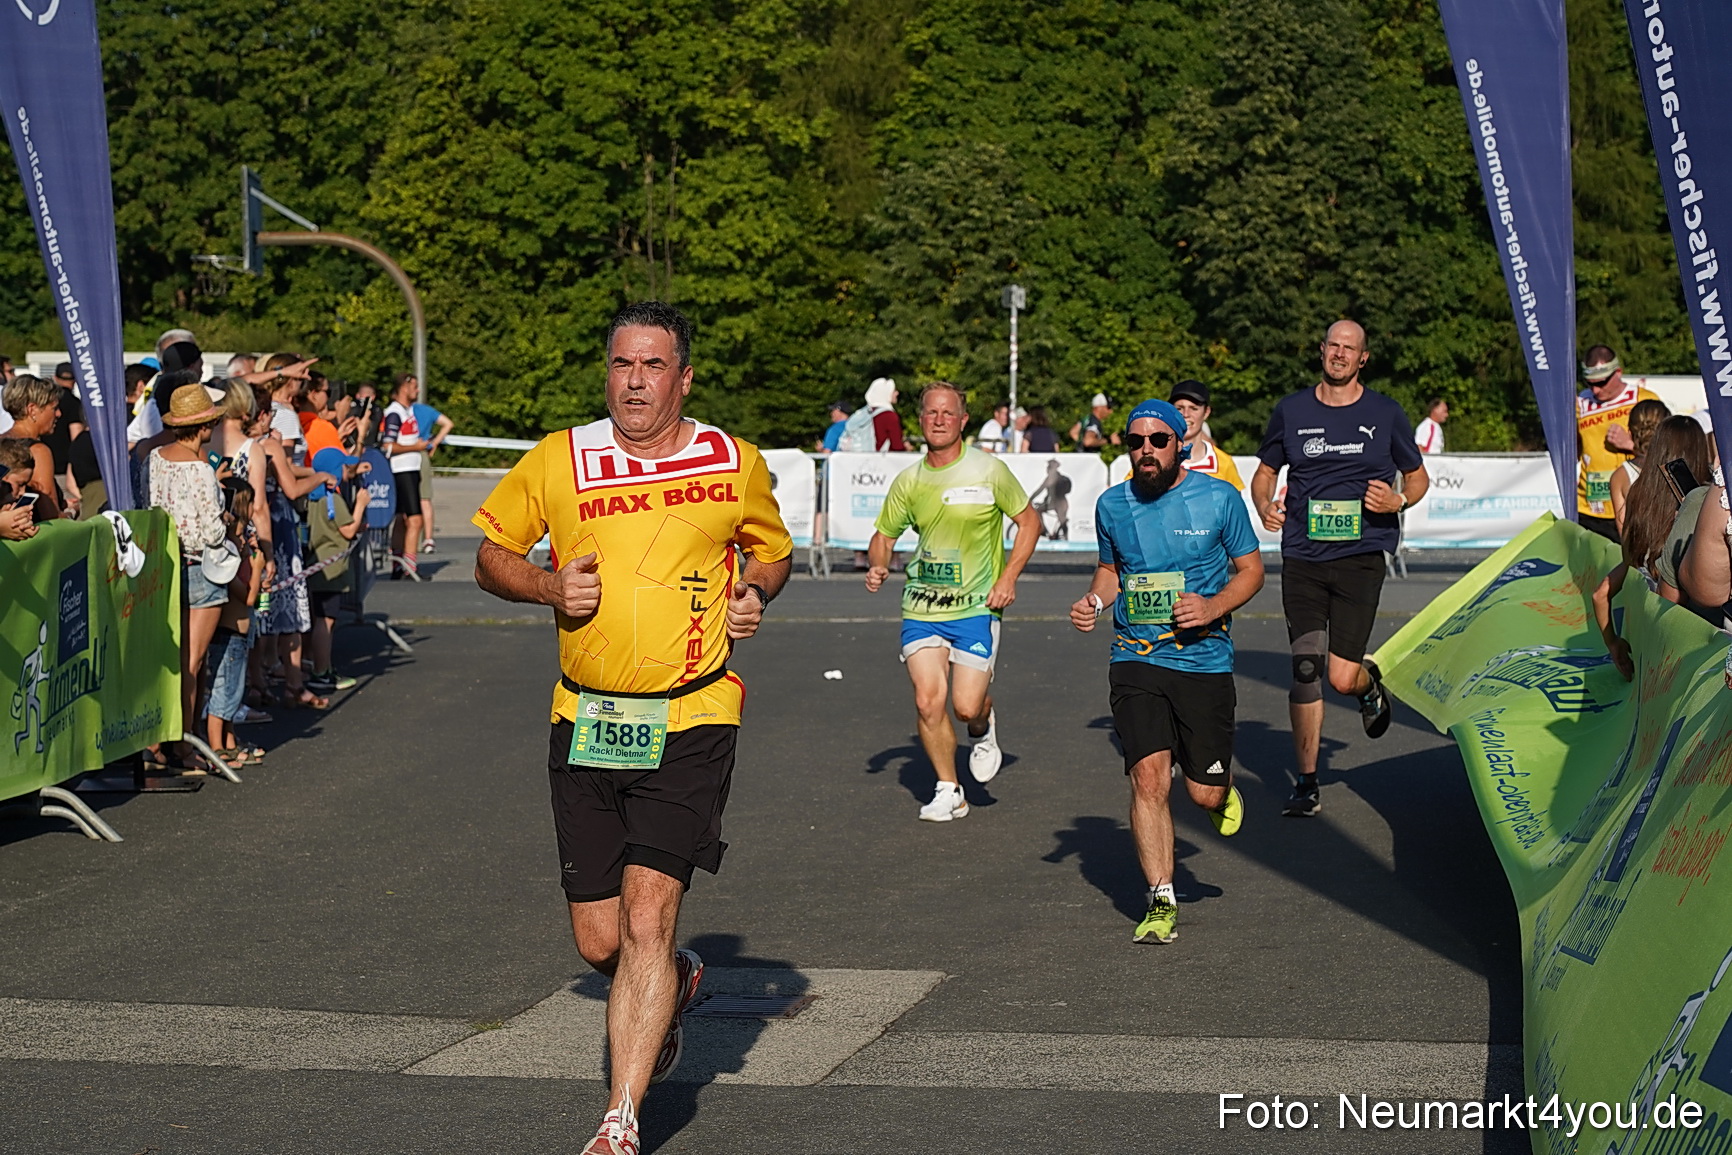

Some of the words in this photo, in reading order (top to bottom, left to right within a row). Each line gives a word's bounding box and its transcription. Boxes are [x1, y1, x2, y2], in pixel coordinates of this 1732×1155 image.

[368, 481, 390, 498] cher
[1591, 481, 1610, 492] 158
[579, 493, 654, 523] MAX
[663, 481, 739, 508] BÖGL
[1317, 515, 1353, 528] 1768
[921, 561, 954, 576] 1475
[63, 592, 82, 615] Fischer
[1133, 590, 1172, 608] 1921
[576, 726, 589, 751] RUN
[592, 720, 651, 747] 1588
[589, 746, 613, 757] Rackl
[615, 748, 648, 758] Dietmar
[649, 728, 663, 760] 2022
